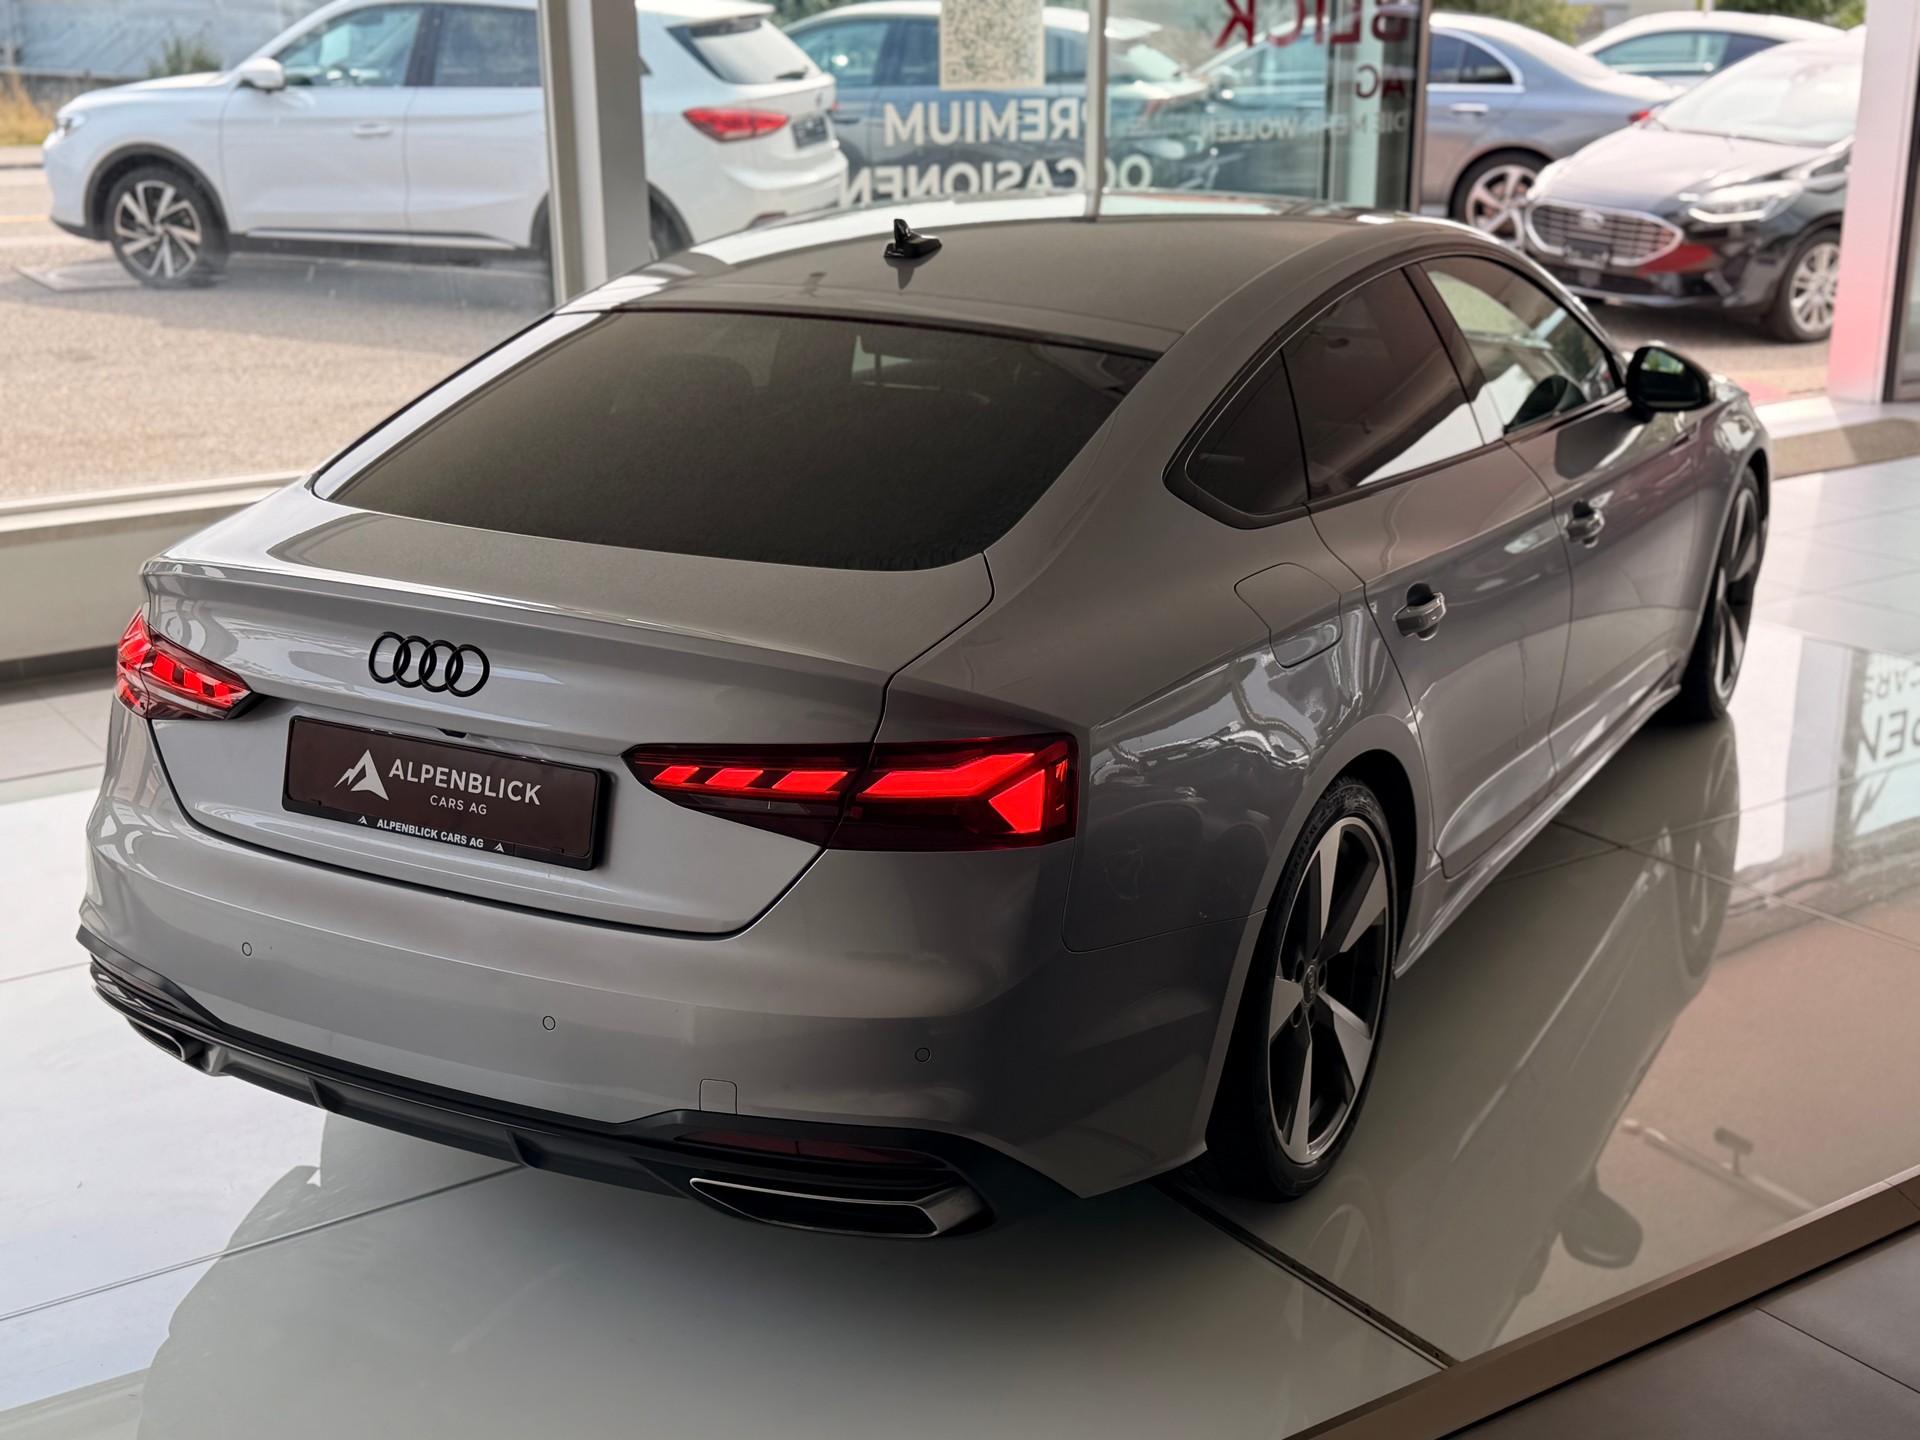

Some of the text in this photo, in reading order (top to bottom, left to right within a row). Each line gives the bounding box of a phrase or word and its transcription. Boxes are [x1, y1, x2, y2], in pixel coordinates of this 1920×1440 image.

[388, 758, 542, 806] ALPENBLICK
[430, 794, 487, 815] CARS AG
[376, 818, 484, 848] ALPENBLICK CARS AG
